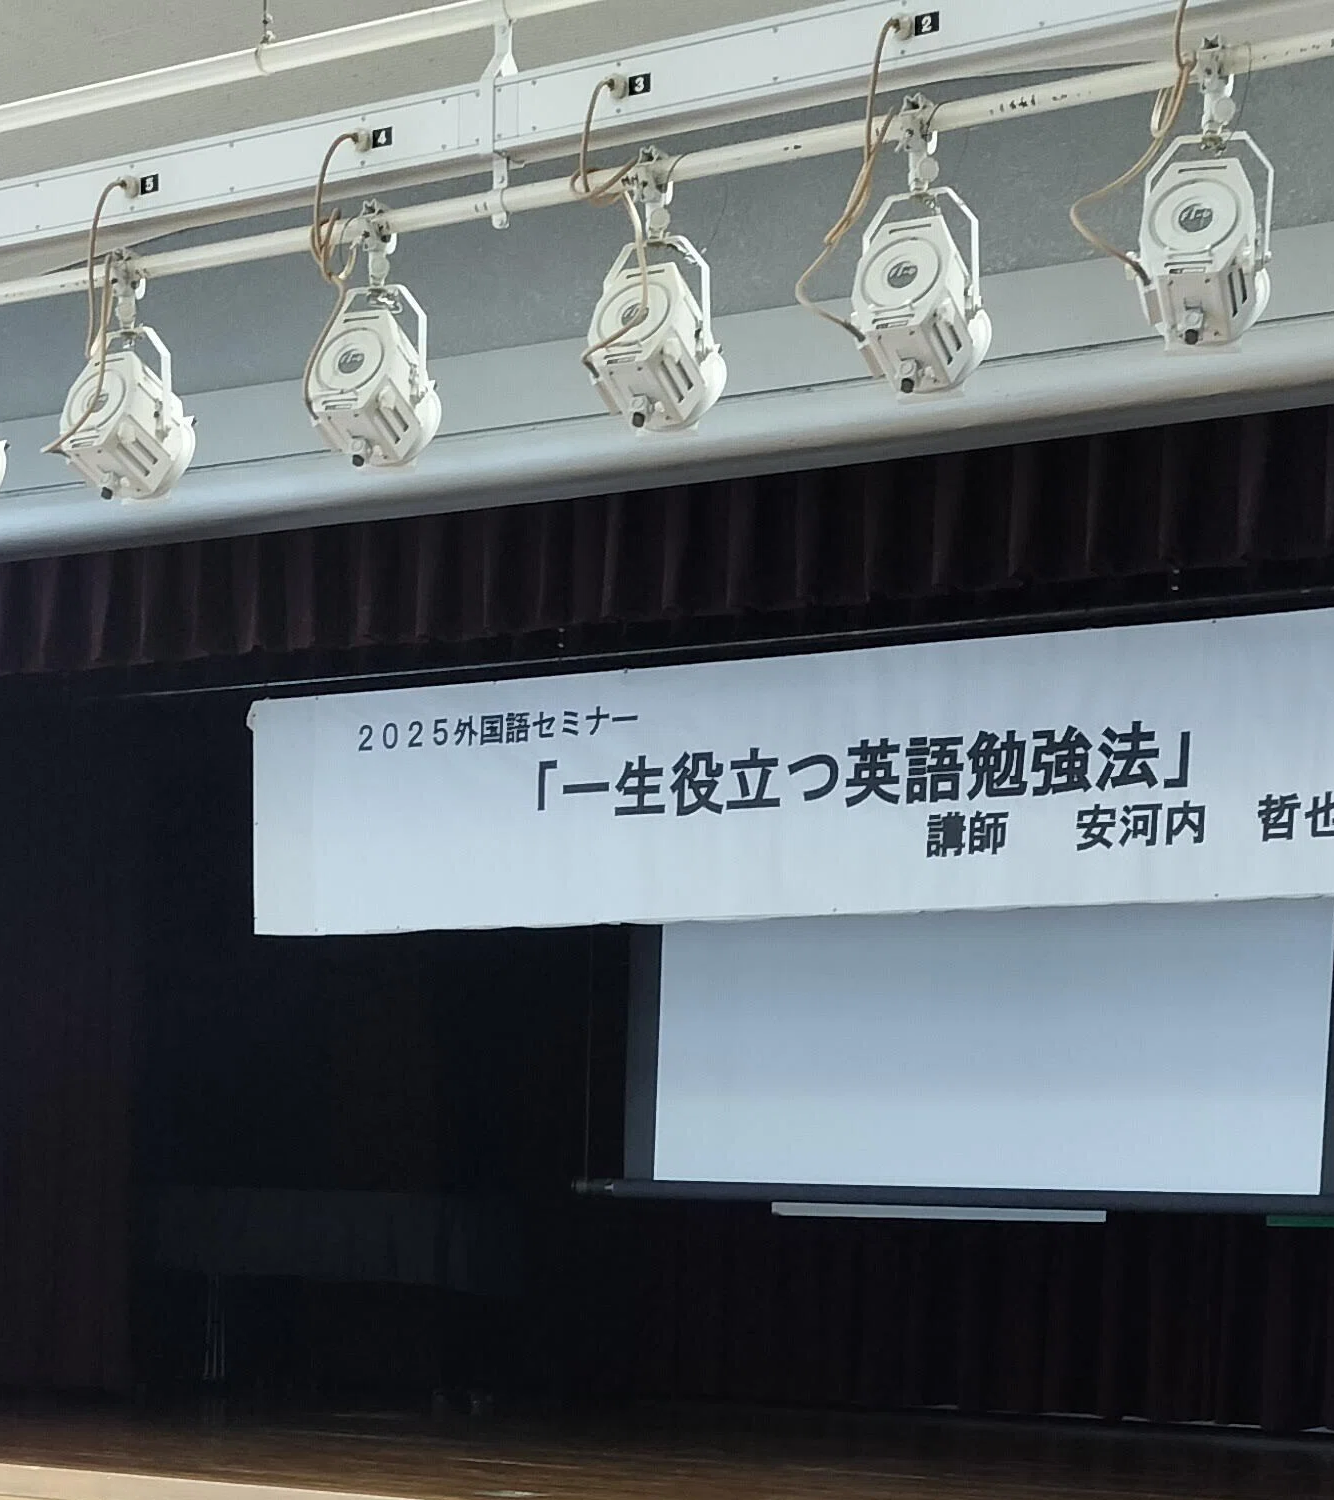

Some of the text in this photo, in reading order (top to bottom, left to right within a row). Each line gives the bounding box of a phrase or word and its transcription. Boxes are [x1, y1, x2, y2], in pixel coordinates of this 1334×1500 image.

[921, 15, 932, 33] 2
[634, 76, 644, 92] 3
[378, 130, 387, 145] 4
[145, 177, 154, 192] 5
[359, 706, 638, 751] 2025外国語セミナー
[537, 721, 1190, 816] 「一生役立つ英語勉強法」
[927, 810, 1009, 858] 講師
[1076, 800, 1206, 851] 安河内
